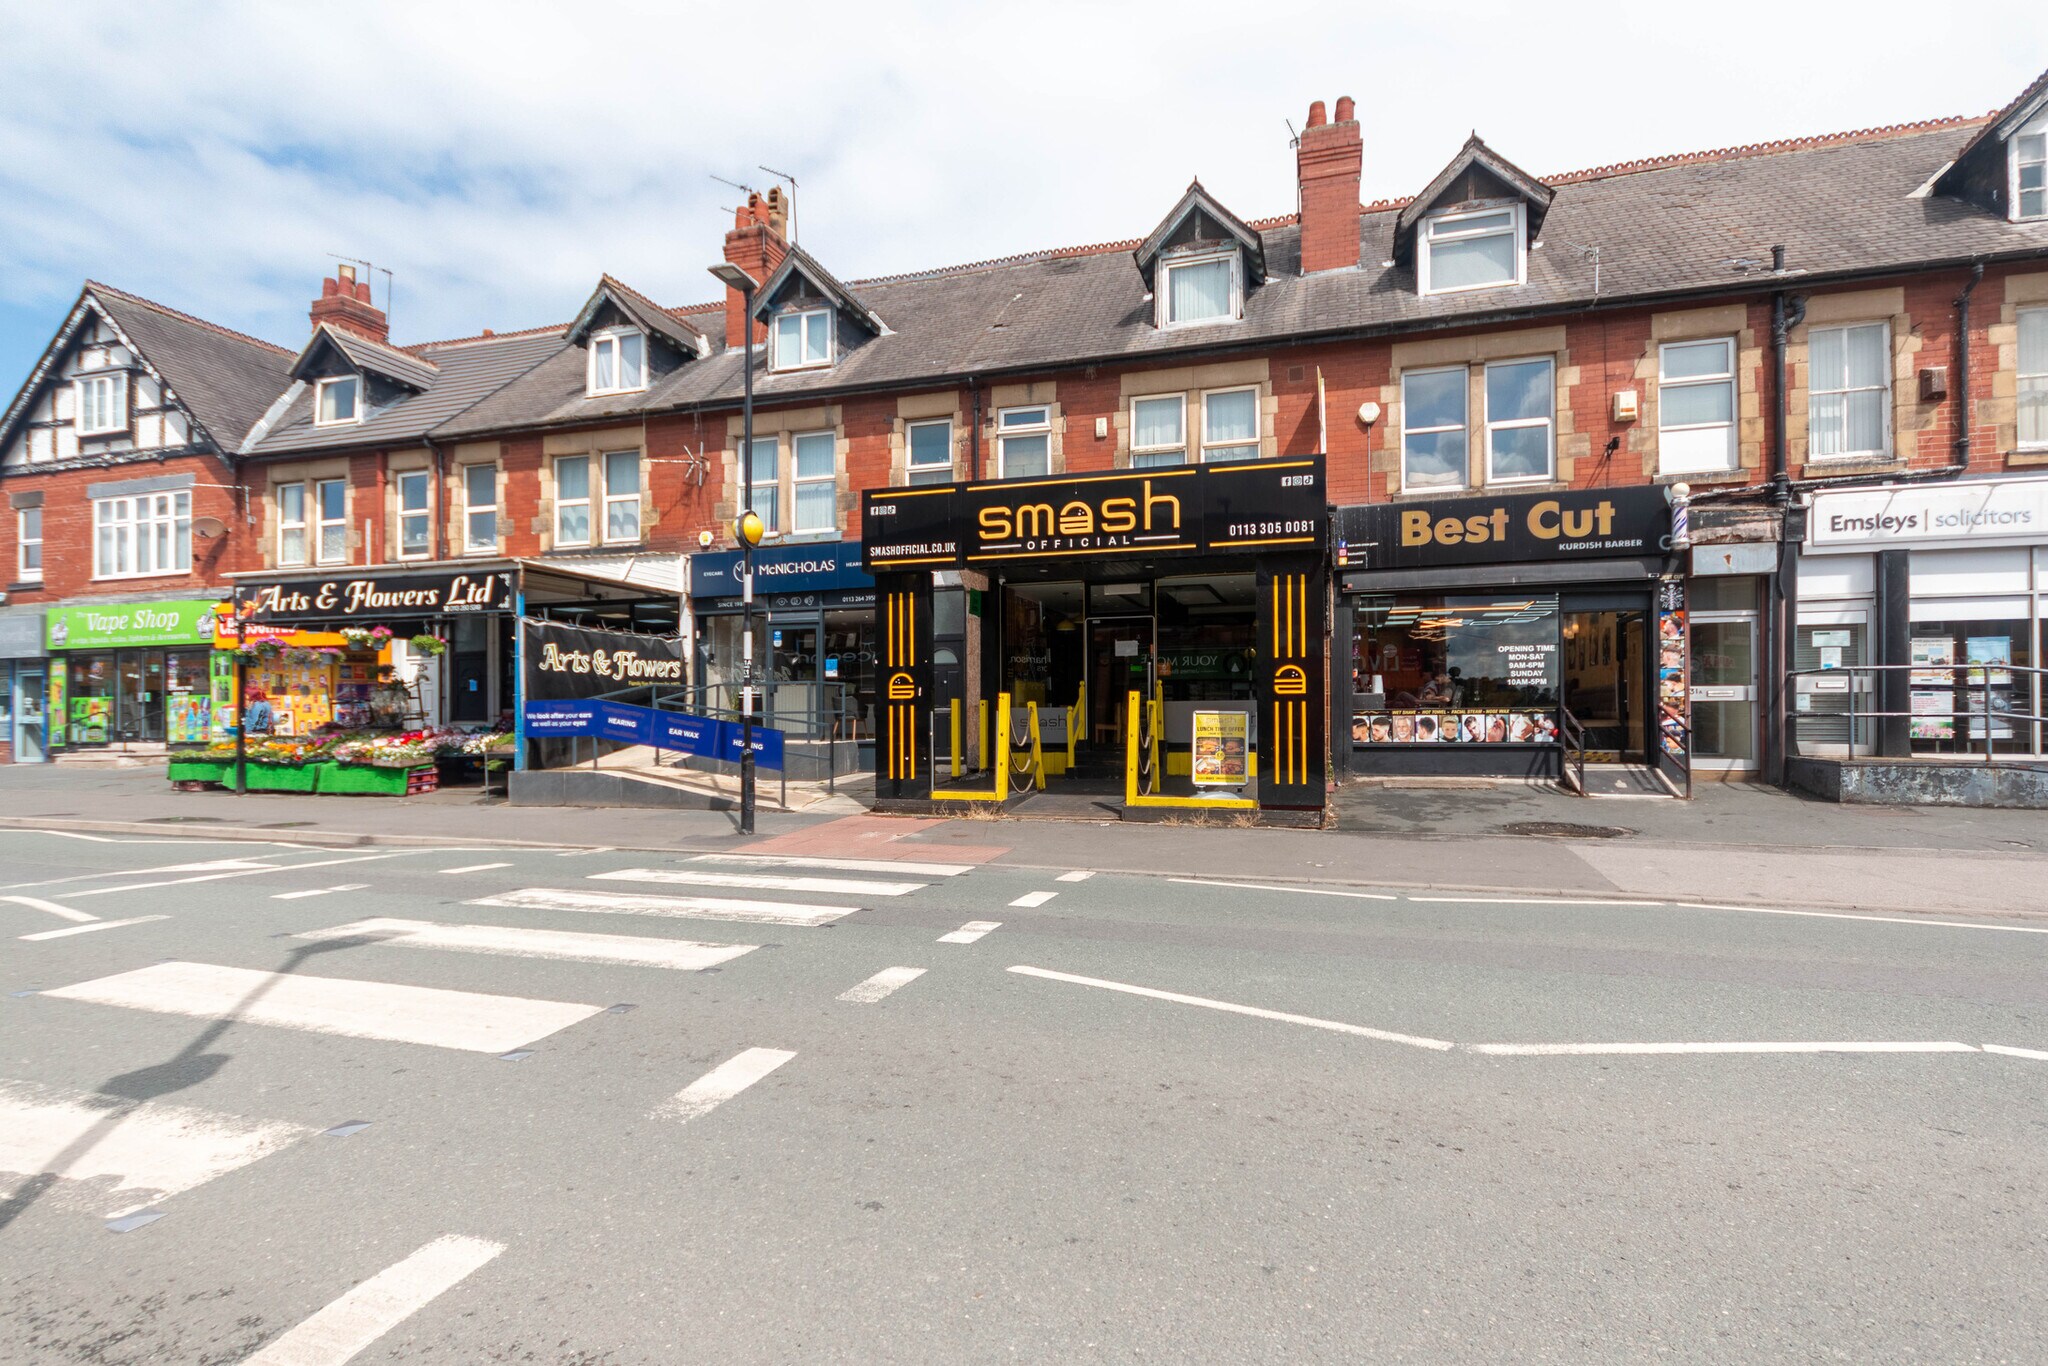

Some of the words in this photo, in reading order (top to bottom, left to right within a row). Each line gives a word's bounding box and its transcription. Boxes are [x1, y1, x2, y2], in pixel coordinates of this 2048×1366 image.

[978, 480, 1181, 540] smash
[1400, 508, 1509, 547] Best
[1527, 501, 1616, 540] Cut
[1830, 512, 1918, 534] Emsleys
[1935, 507, 2032, 528] solicitors
[1229, 522, 1256, 537] 0113
[1259, 521, 1282, 536] 305
[1285, 520, 1315, 534] 0081
[870, 542, 956, 558] SMASHOFFICIAL.CO.UK
[1027, 536, 1130, 550] OFFICIAL
[1559, 541, 1602, 551] KURDISH
[1605, 539, 1643, 549] BARBER
[758, 559, 836, 576] McNICHOLAS
[257, 584, 311, 613] Arts
[315, 582, 338, 609] &
[344, 581, 439, 613] Flowers
[444, 575, 495, 605] Ltd
[85, 612, 129, 634] Vape
[133, 609, 180, 631] Shop
[1498, 645, 1534, 653] OPENING
[1536, 644, 1556, 652] TIME
[539, 642, 590, 673] Arts
[592, 649, 612, 676] &
[612, 650, 681, 681] Flowers
[1508, 653, 1545, 661] MON-SAT
[1508, 661, 1545, 669] 9AM-6PM
[559, 720, 572, 728] your
[607, 716, 637, 728] HEARING
[1020, 715, 1067, 728] sash
[668, 727, 683, 737] EAR
[683, 729, 699, 739] WAX
[732, 738, 764, 751] HEING
